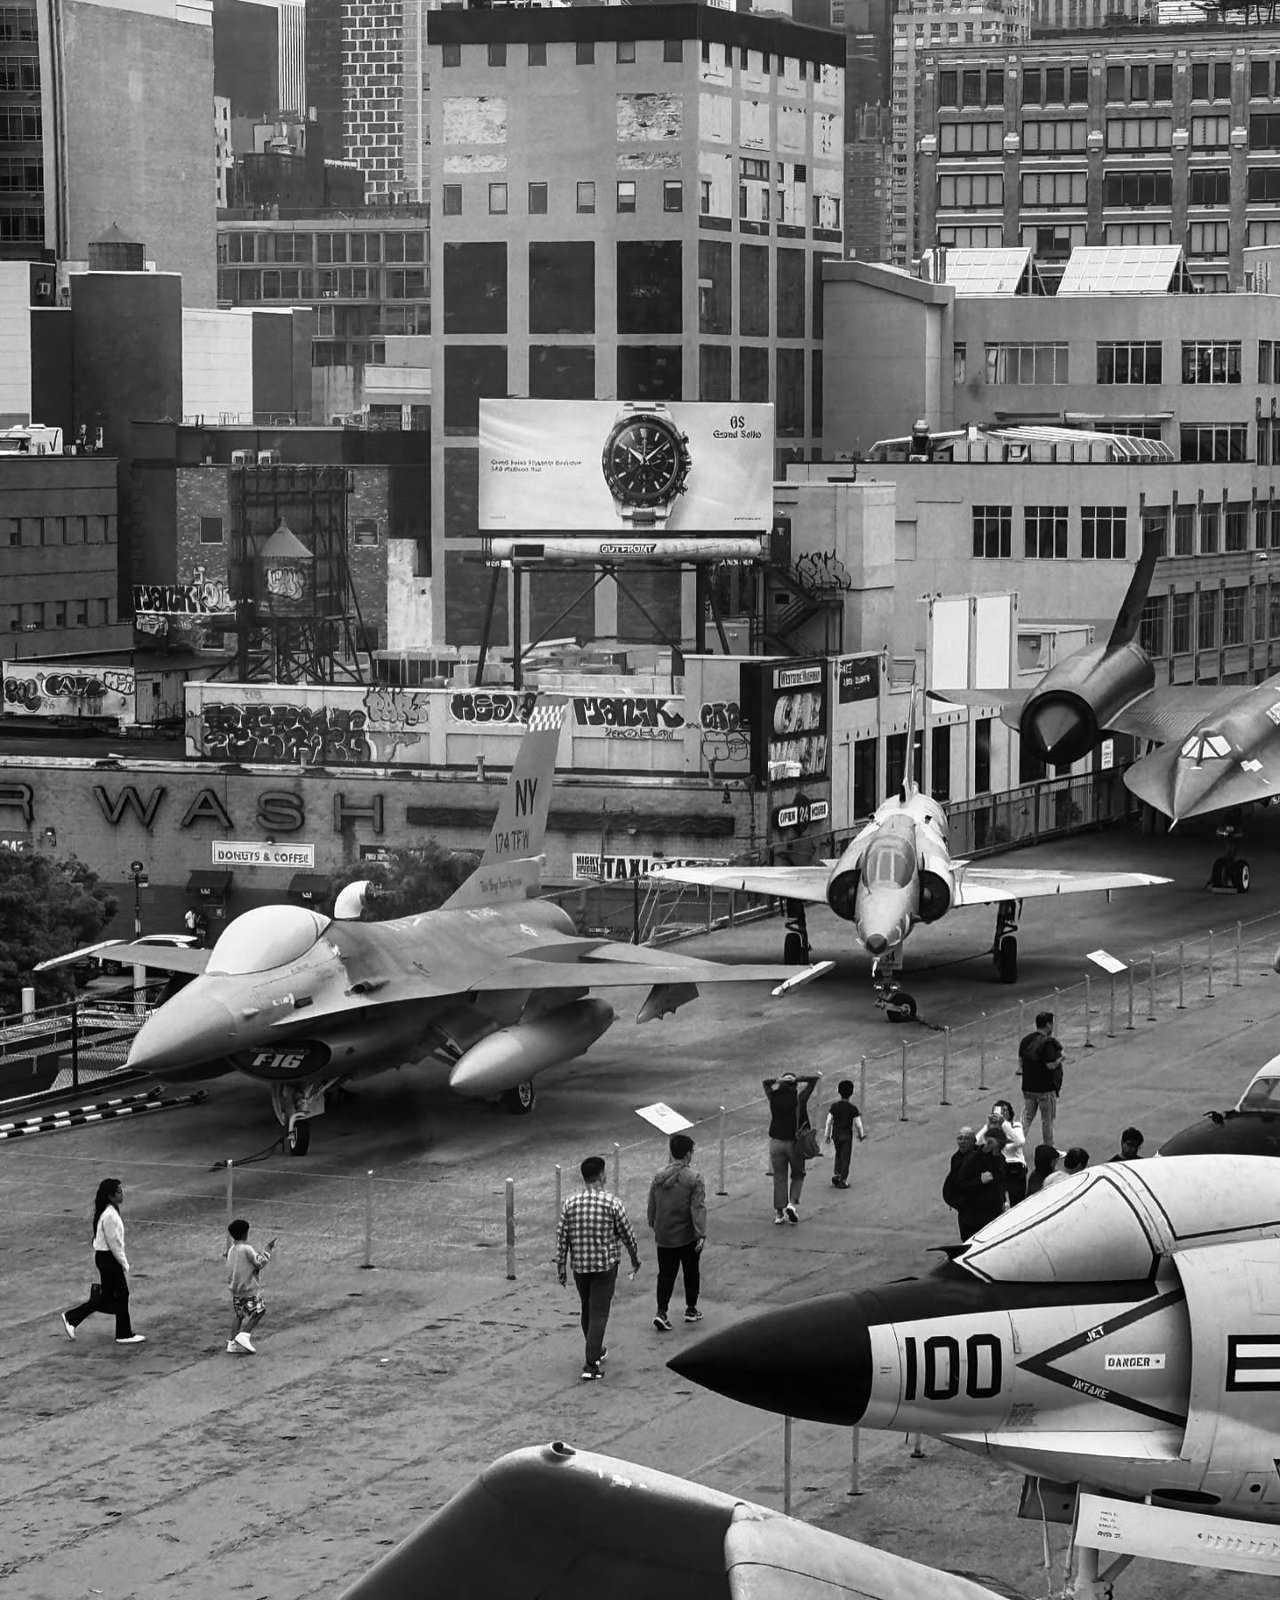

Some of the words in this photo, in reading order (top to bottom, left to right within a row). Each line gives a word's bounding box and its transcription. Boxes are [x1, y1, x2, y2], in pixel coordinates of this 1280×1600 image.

[601, 544, 654, 554] OUTFRONT
[515, 778, 538, 817] NY
[94, 784, 386, 834] WASH
[218, 850, 260, 861] DONUTS
[263, 852, 271, 861] &
[274, 853, 309, 863] COFFEE
[252, 1053, 305, 1068] F-16
[1086, 1325, 1105, 1342] JET
[905, 1333, 1002, 1400] 100
[1108, 1357, 1150, 1367] DANGER
[1072, 1378, 1110, 1399] INTAKE
